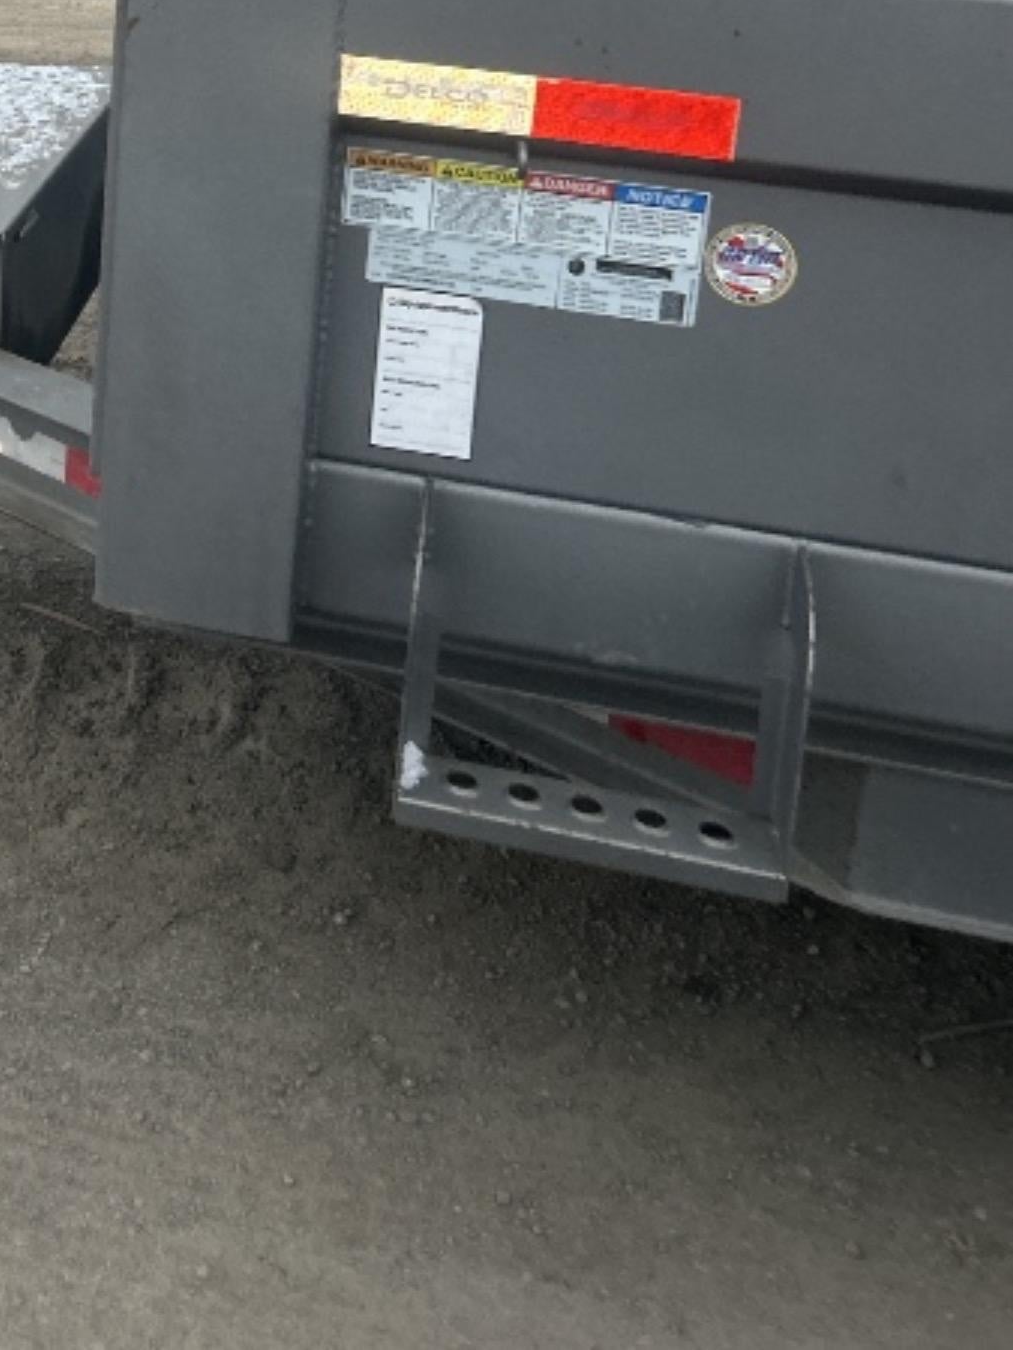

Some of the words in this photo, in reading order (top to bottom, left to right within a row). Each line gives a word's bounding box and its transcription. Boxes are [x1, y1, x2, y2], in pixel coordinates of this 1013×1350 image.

[367, 153, 430, 173] WARNING
[454, 166, 520, 184] CAUTION
[543, 175, 609, 197] DANGER
[625, 187, 695, 209] NOTICE
